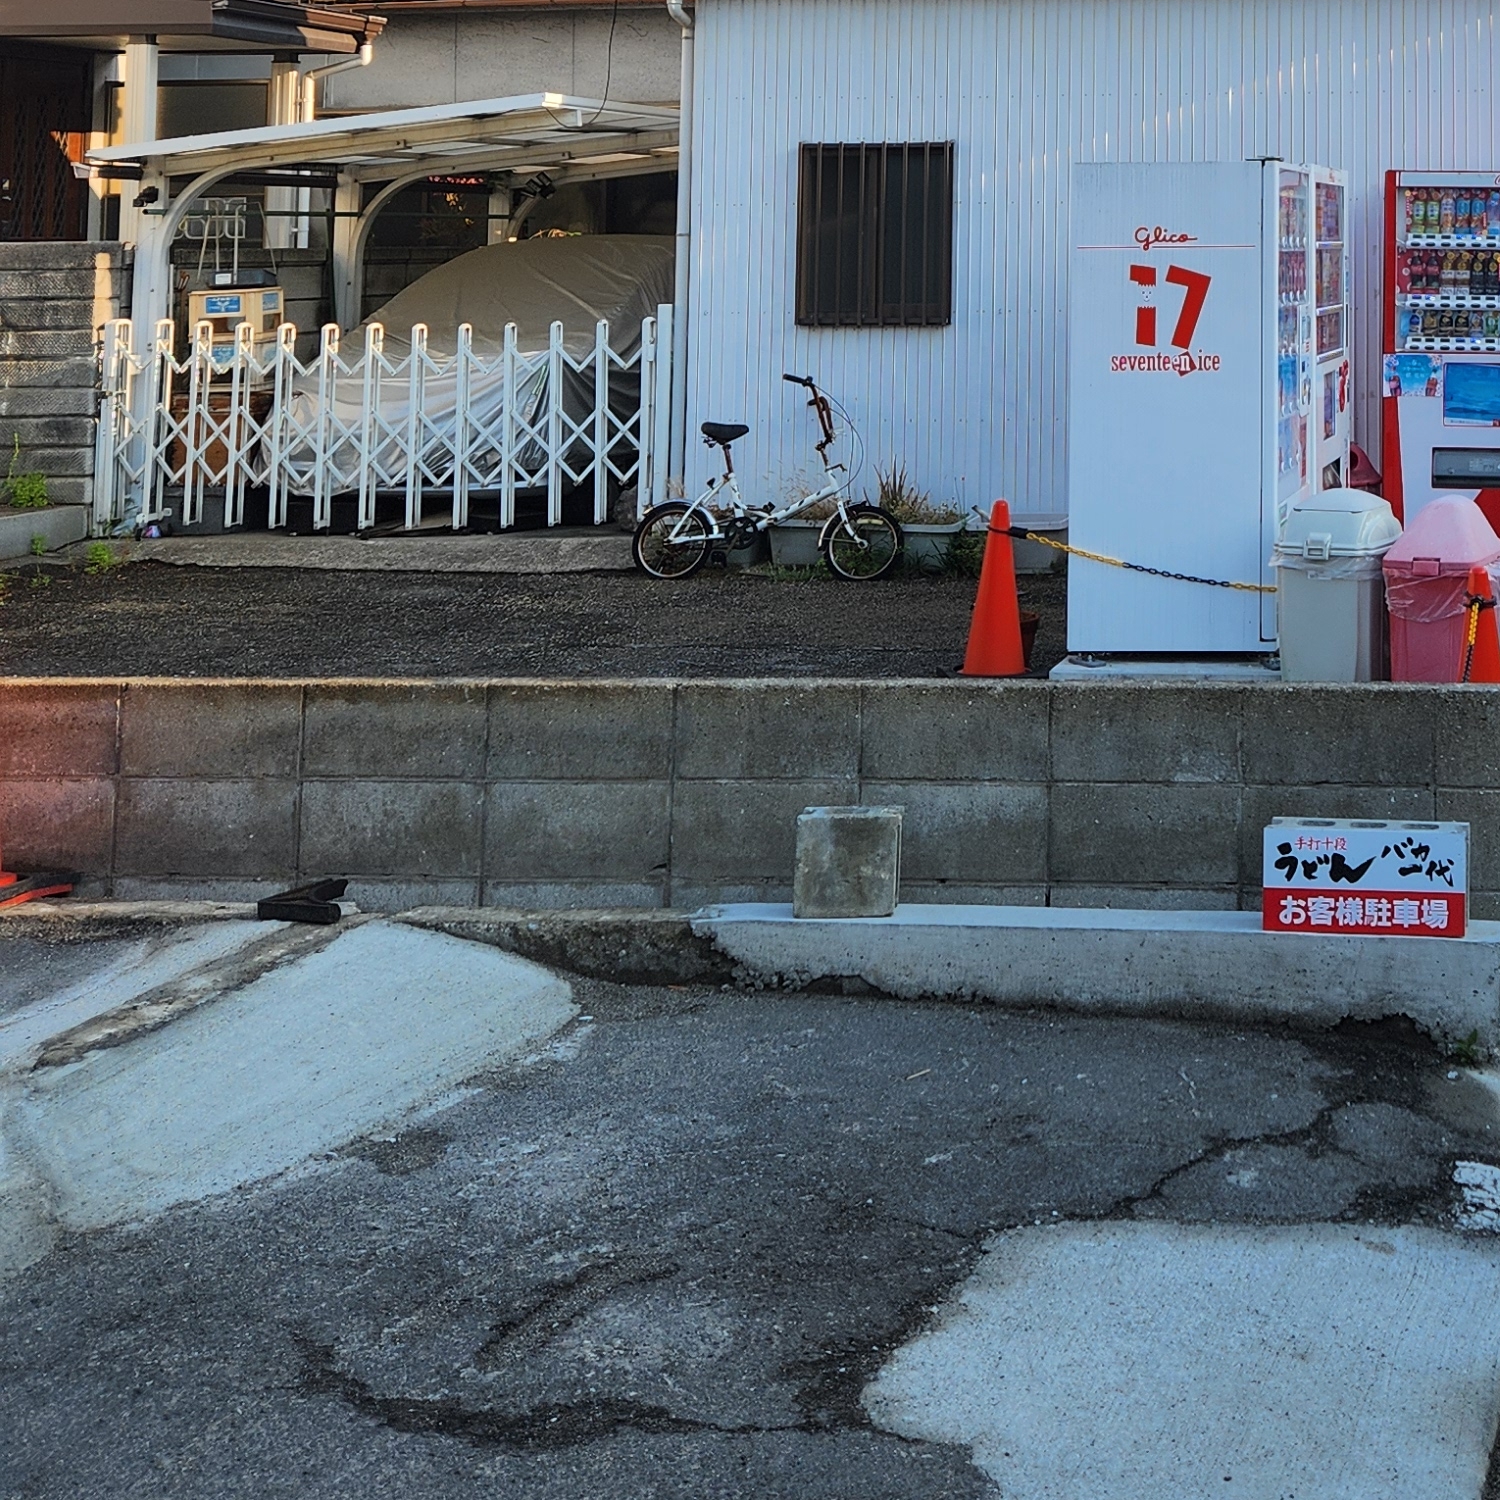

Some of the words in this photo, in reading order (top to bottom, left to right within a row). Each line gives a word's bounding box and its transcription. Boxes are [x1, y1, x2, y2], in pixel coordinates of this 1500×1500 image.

[1134, 226, 1198, 251] Glico
[1111, 352, 1192, 372] seventeen
[1197, 349, 1220, 372] ice
[1294, 836, 1347, 851] 手打十段
[1278, 895, 1449, 930] お客様駐車場
